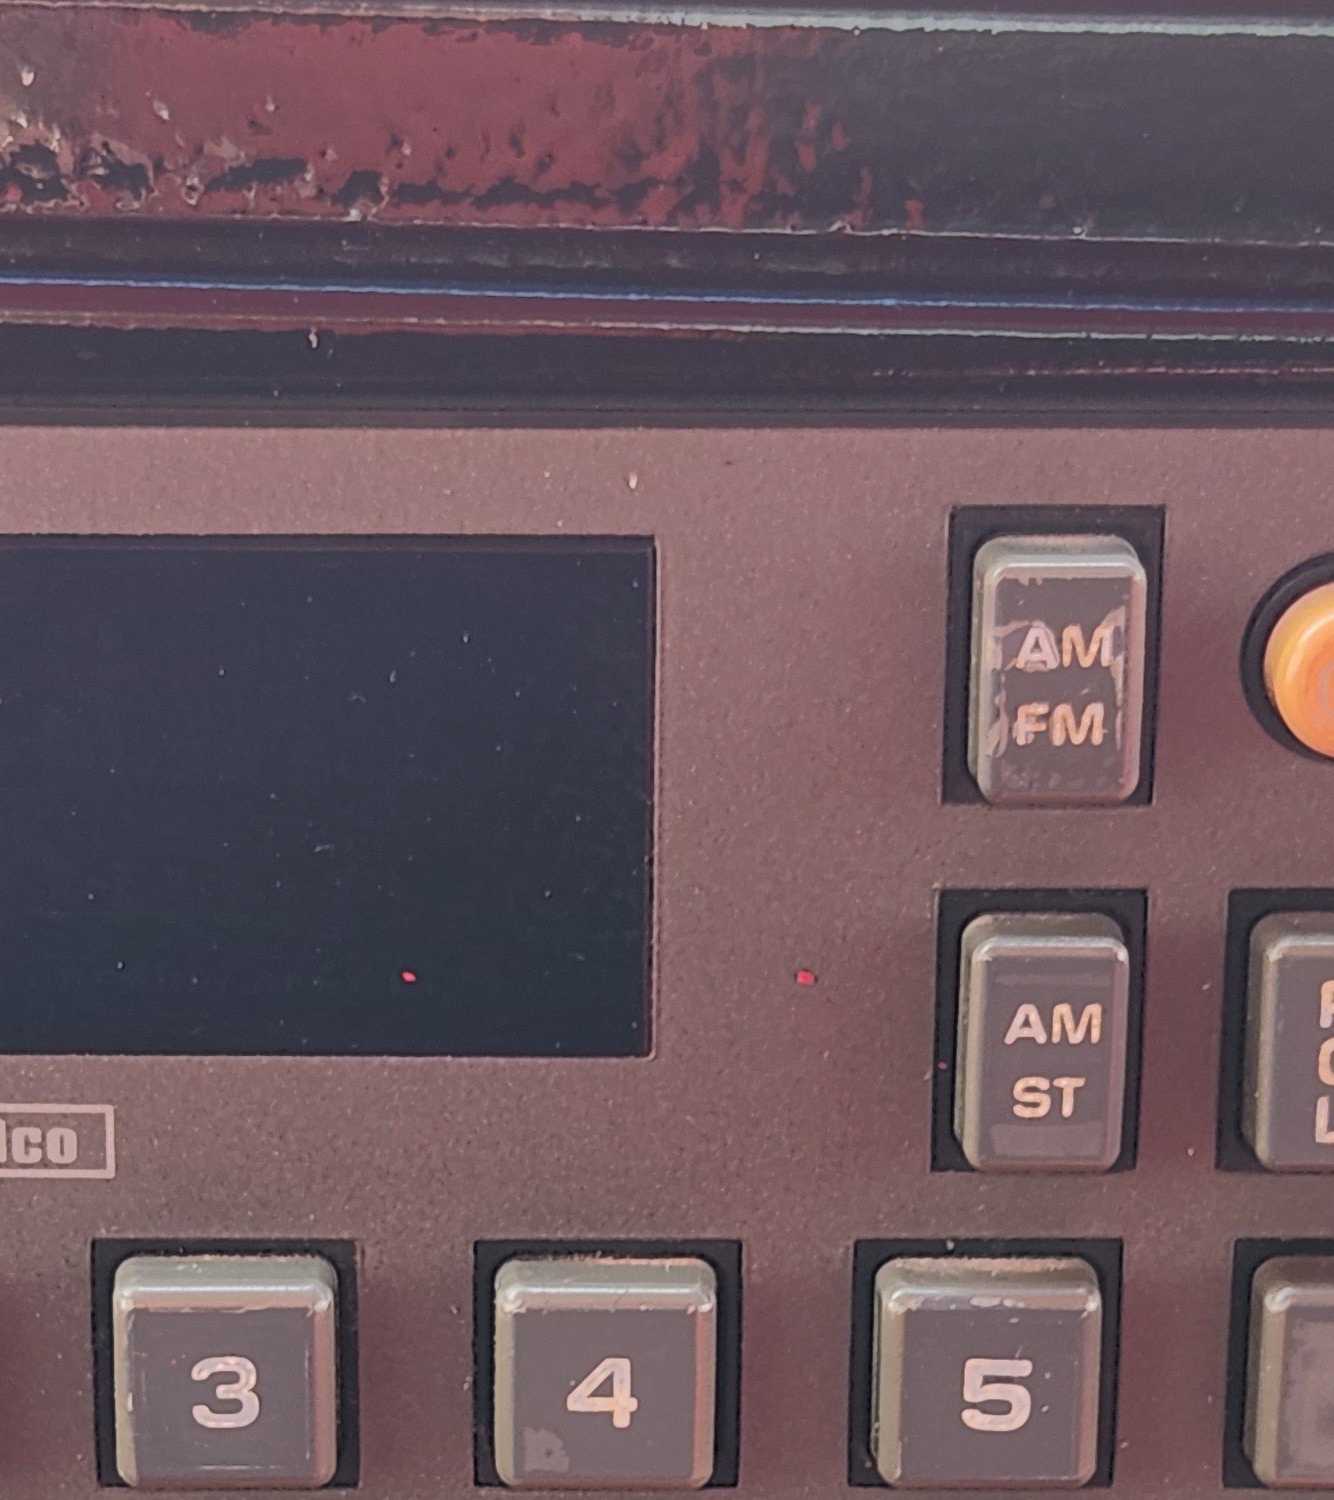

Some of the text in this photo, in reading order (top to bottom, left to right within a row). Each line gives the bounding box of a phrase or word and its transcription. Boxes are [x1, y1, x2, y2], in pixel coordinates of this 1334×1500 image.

[1016, 626, 1114, 670] AM
[1015, 702, 1105, 747] FM
[1004, 1004, 1102, 1046] AM
[1013, 1077, 1085, 1119] ST
[189, 1357, 261, 1429] 3
[566, 1357, 638, 1429] 4
[959, 1358, 1034, 1432] 5
